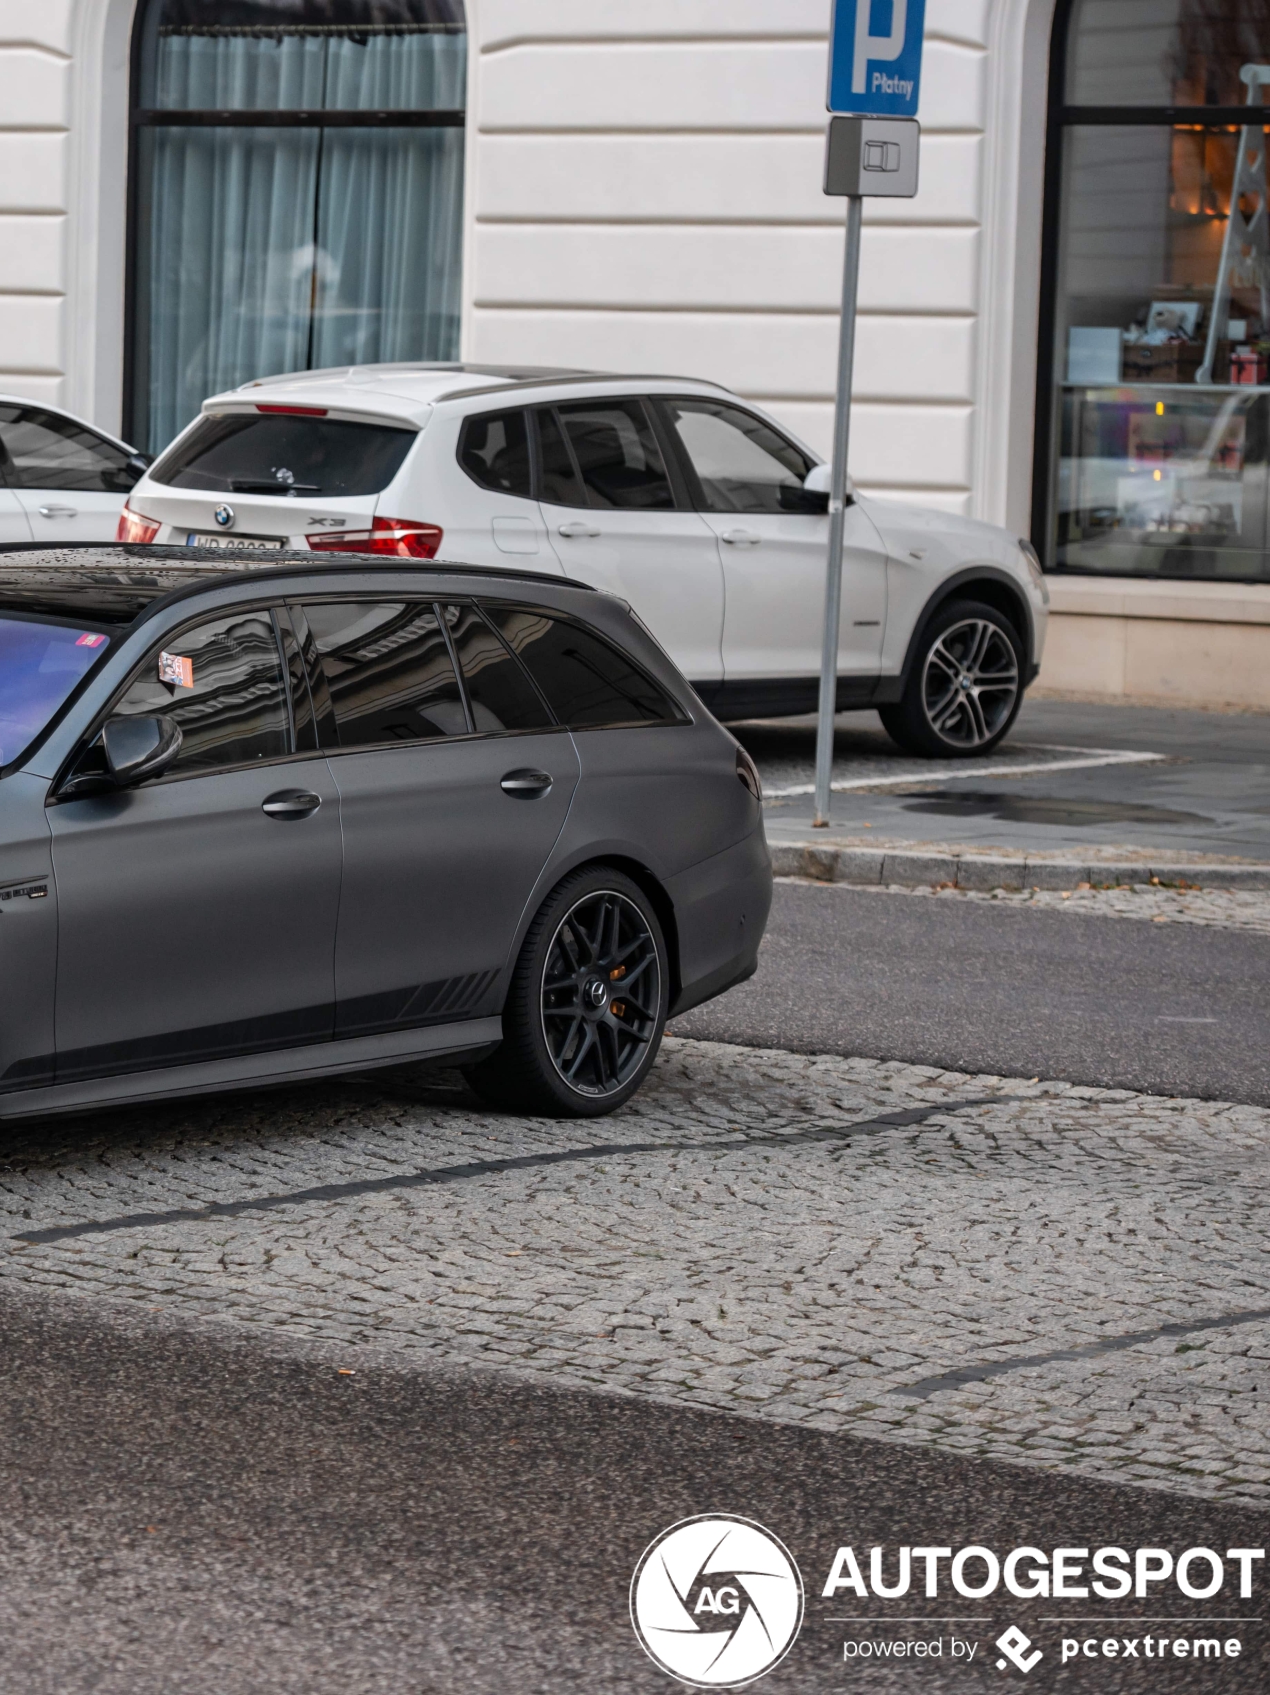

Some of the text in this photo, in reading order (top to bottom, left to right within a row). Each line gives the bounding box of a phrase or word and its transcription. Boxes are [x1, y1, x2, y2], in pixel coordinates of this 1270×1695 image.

[851, 0, 907, 94] P
[871, 71, 914, 101] Płatny
[307, 516, 347, 527] X3
